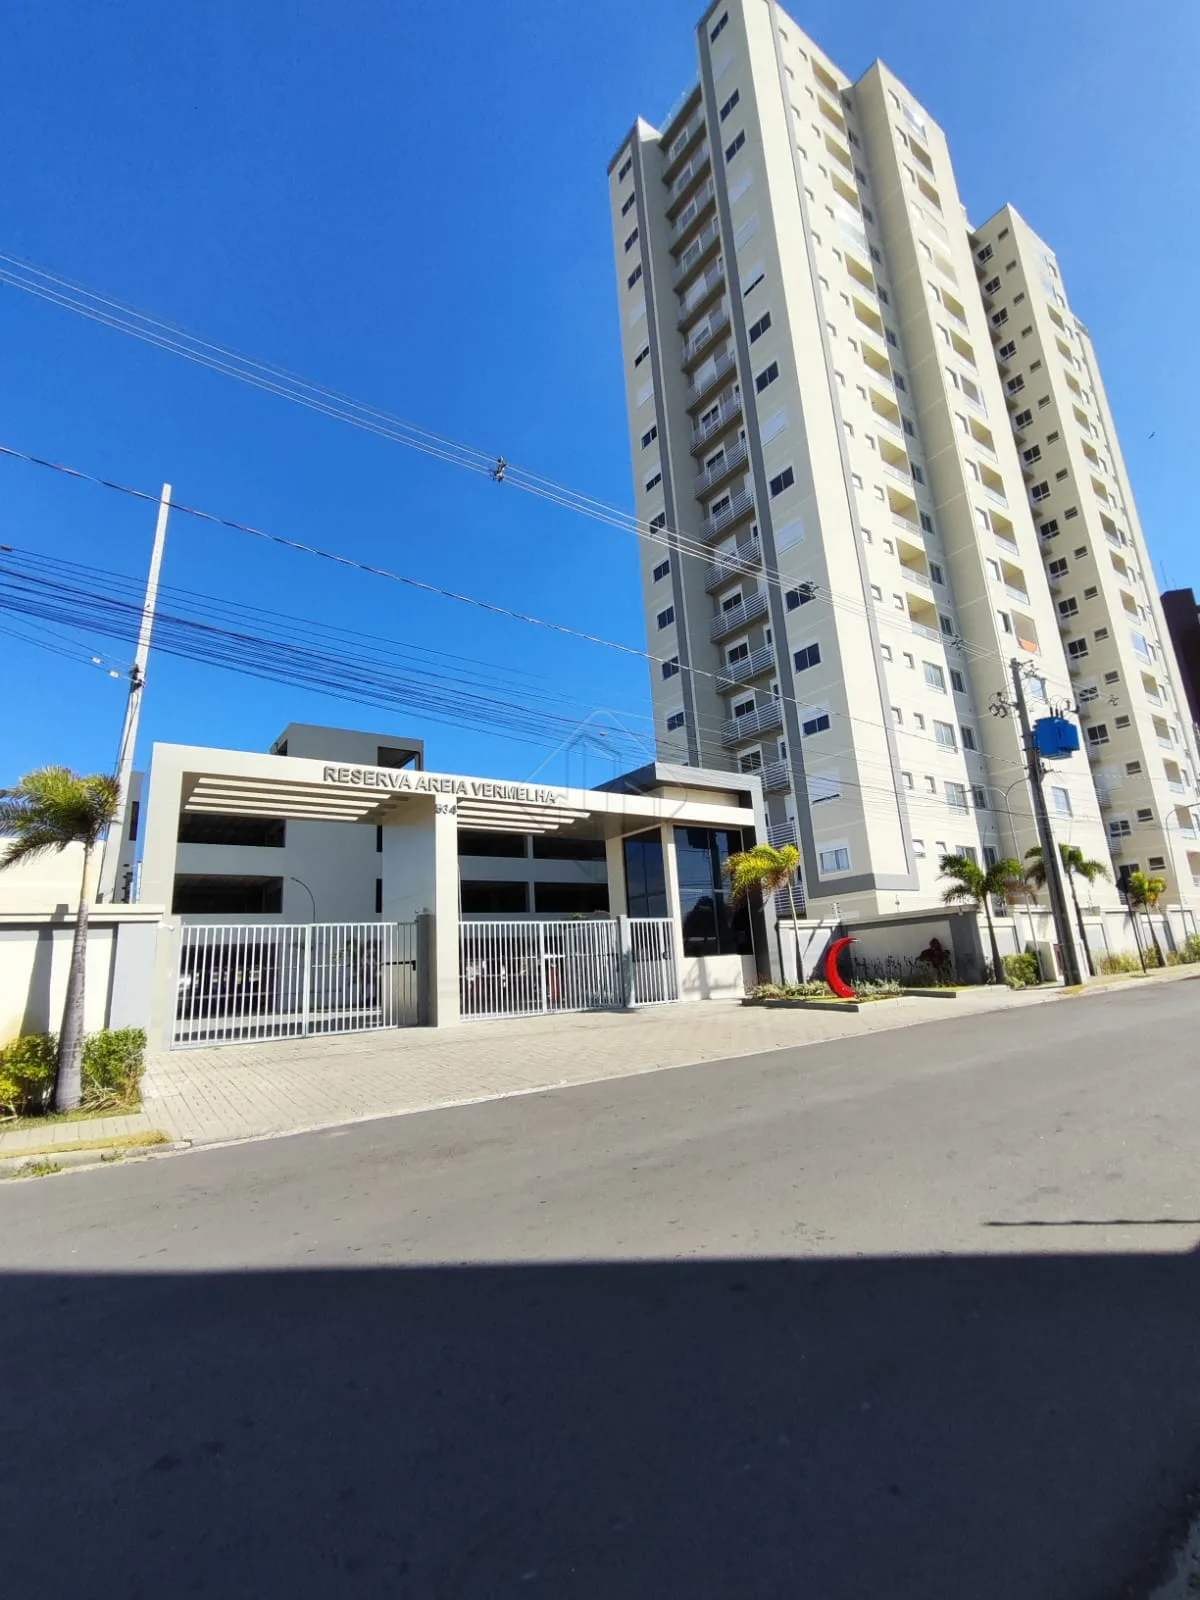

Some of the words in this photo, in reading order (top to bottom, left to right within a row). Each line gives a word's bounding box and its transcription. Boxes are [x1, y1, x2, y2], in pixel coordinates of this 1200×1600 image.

[323, 765, 411, 790] RESERVA
[415, 776, 468, 796] AREIA
[470, 781, 556, 804] VERMELHA
